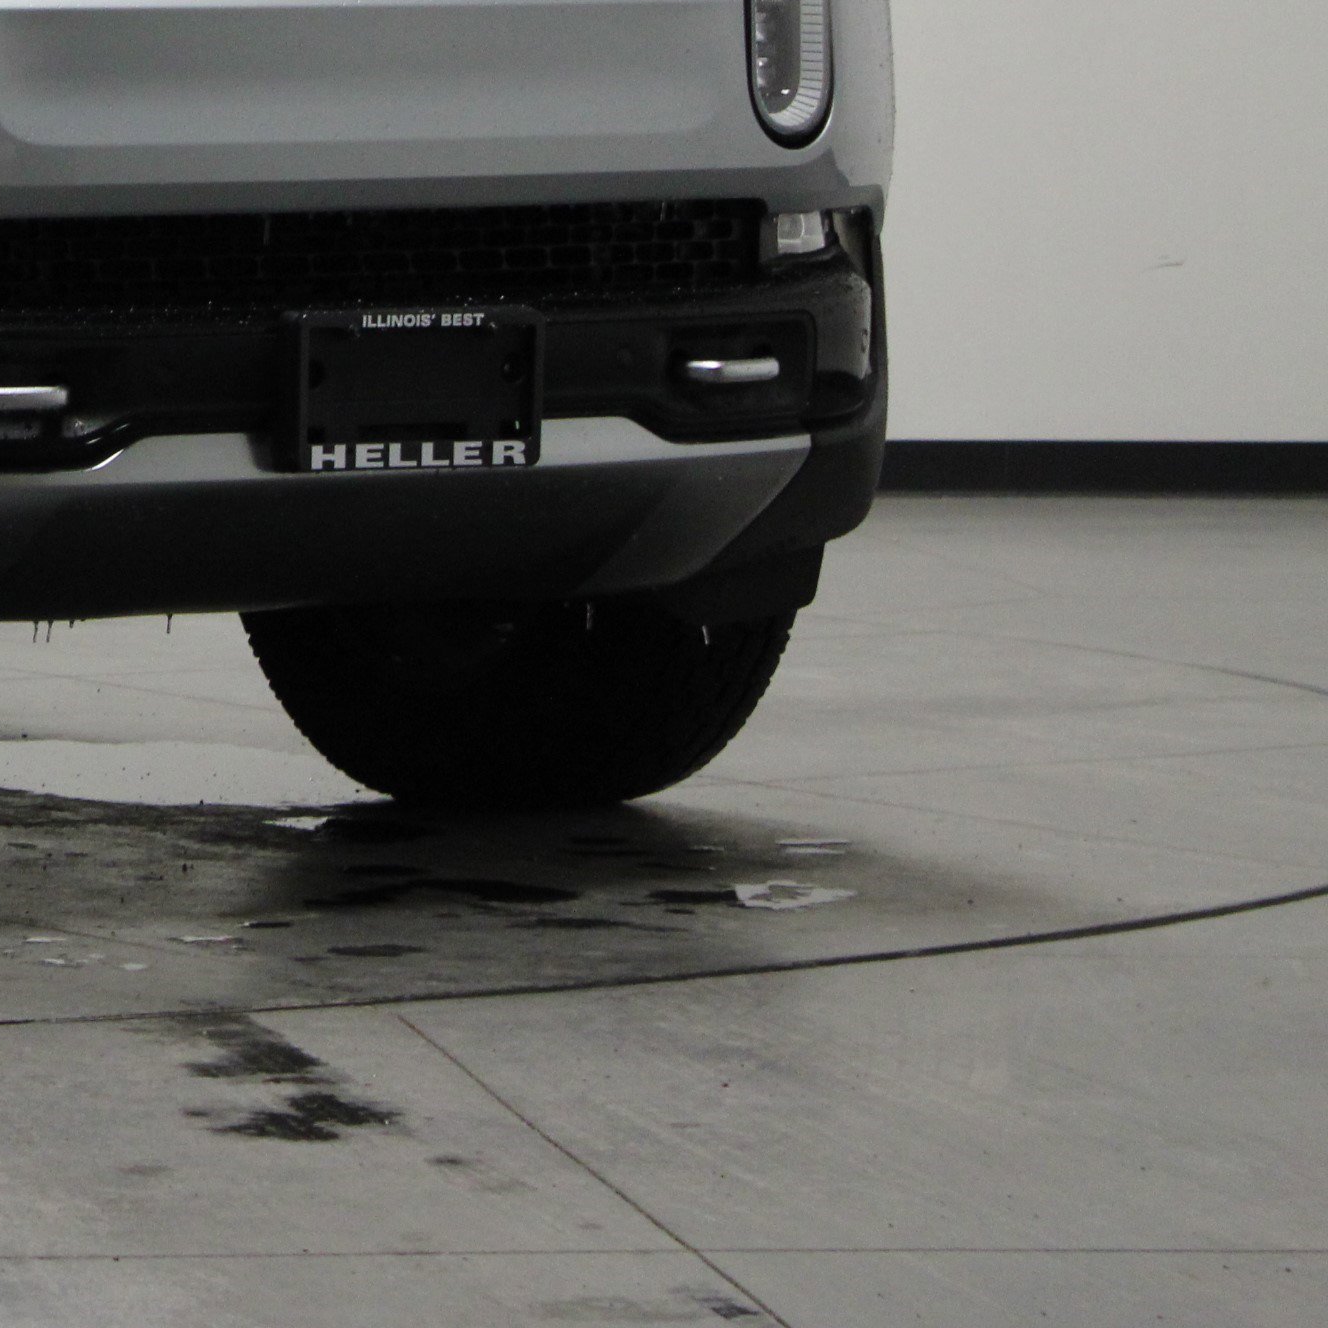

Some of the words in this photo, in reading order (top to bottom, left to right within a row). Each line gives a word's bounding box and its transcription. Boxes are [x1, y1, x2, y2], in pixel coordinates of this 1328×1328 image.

[362, 313, 436, 328] ILLINOIS'
[440, 312, 485, 327] BEST
[310, 440, 527, 470] HELLER
